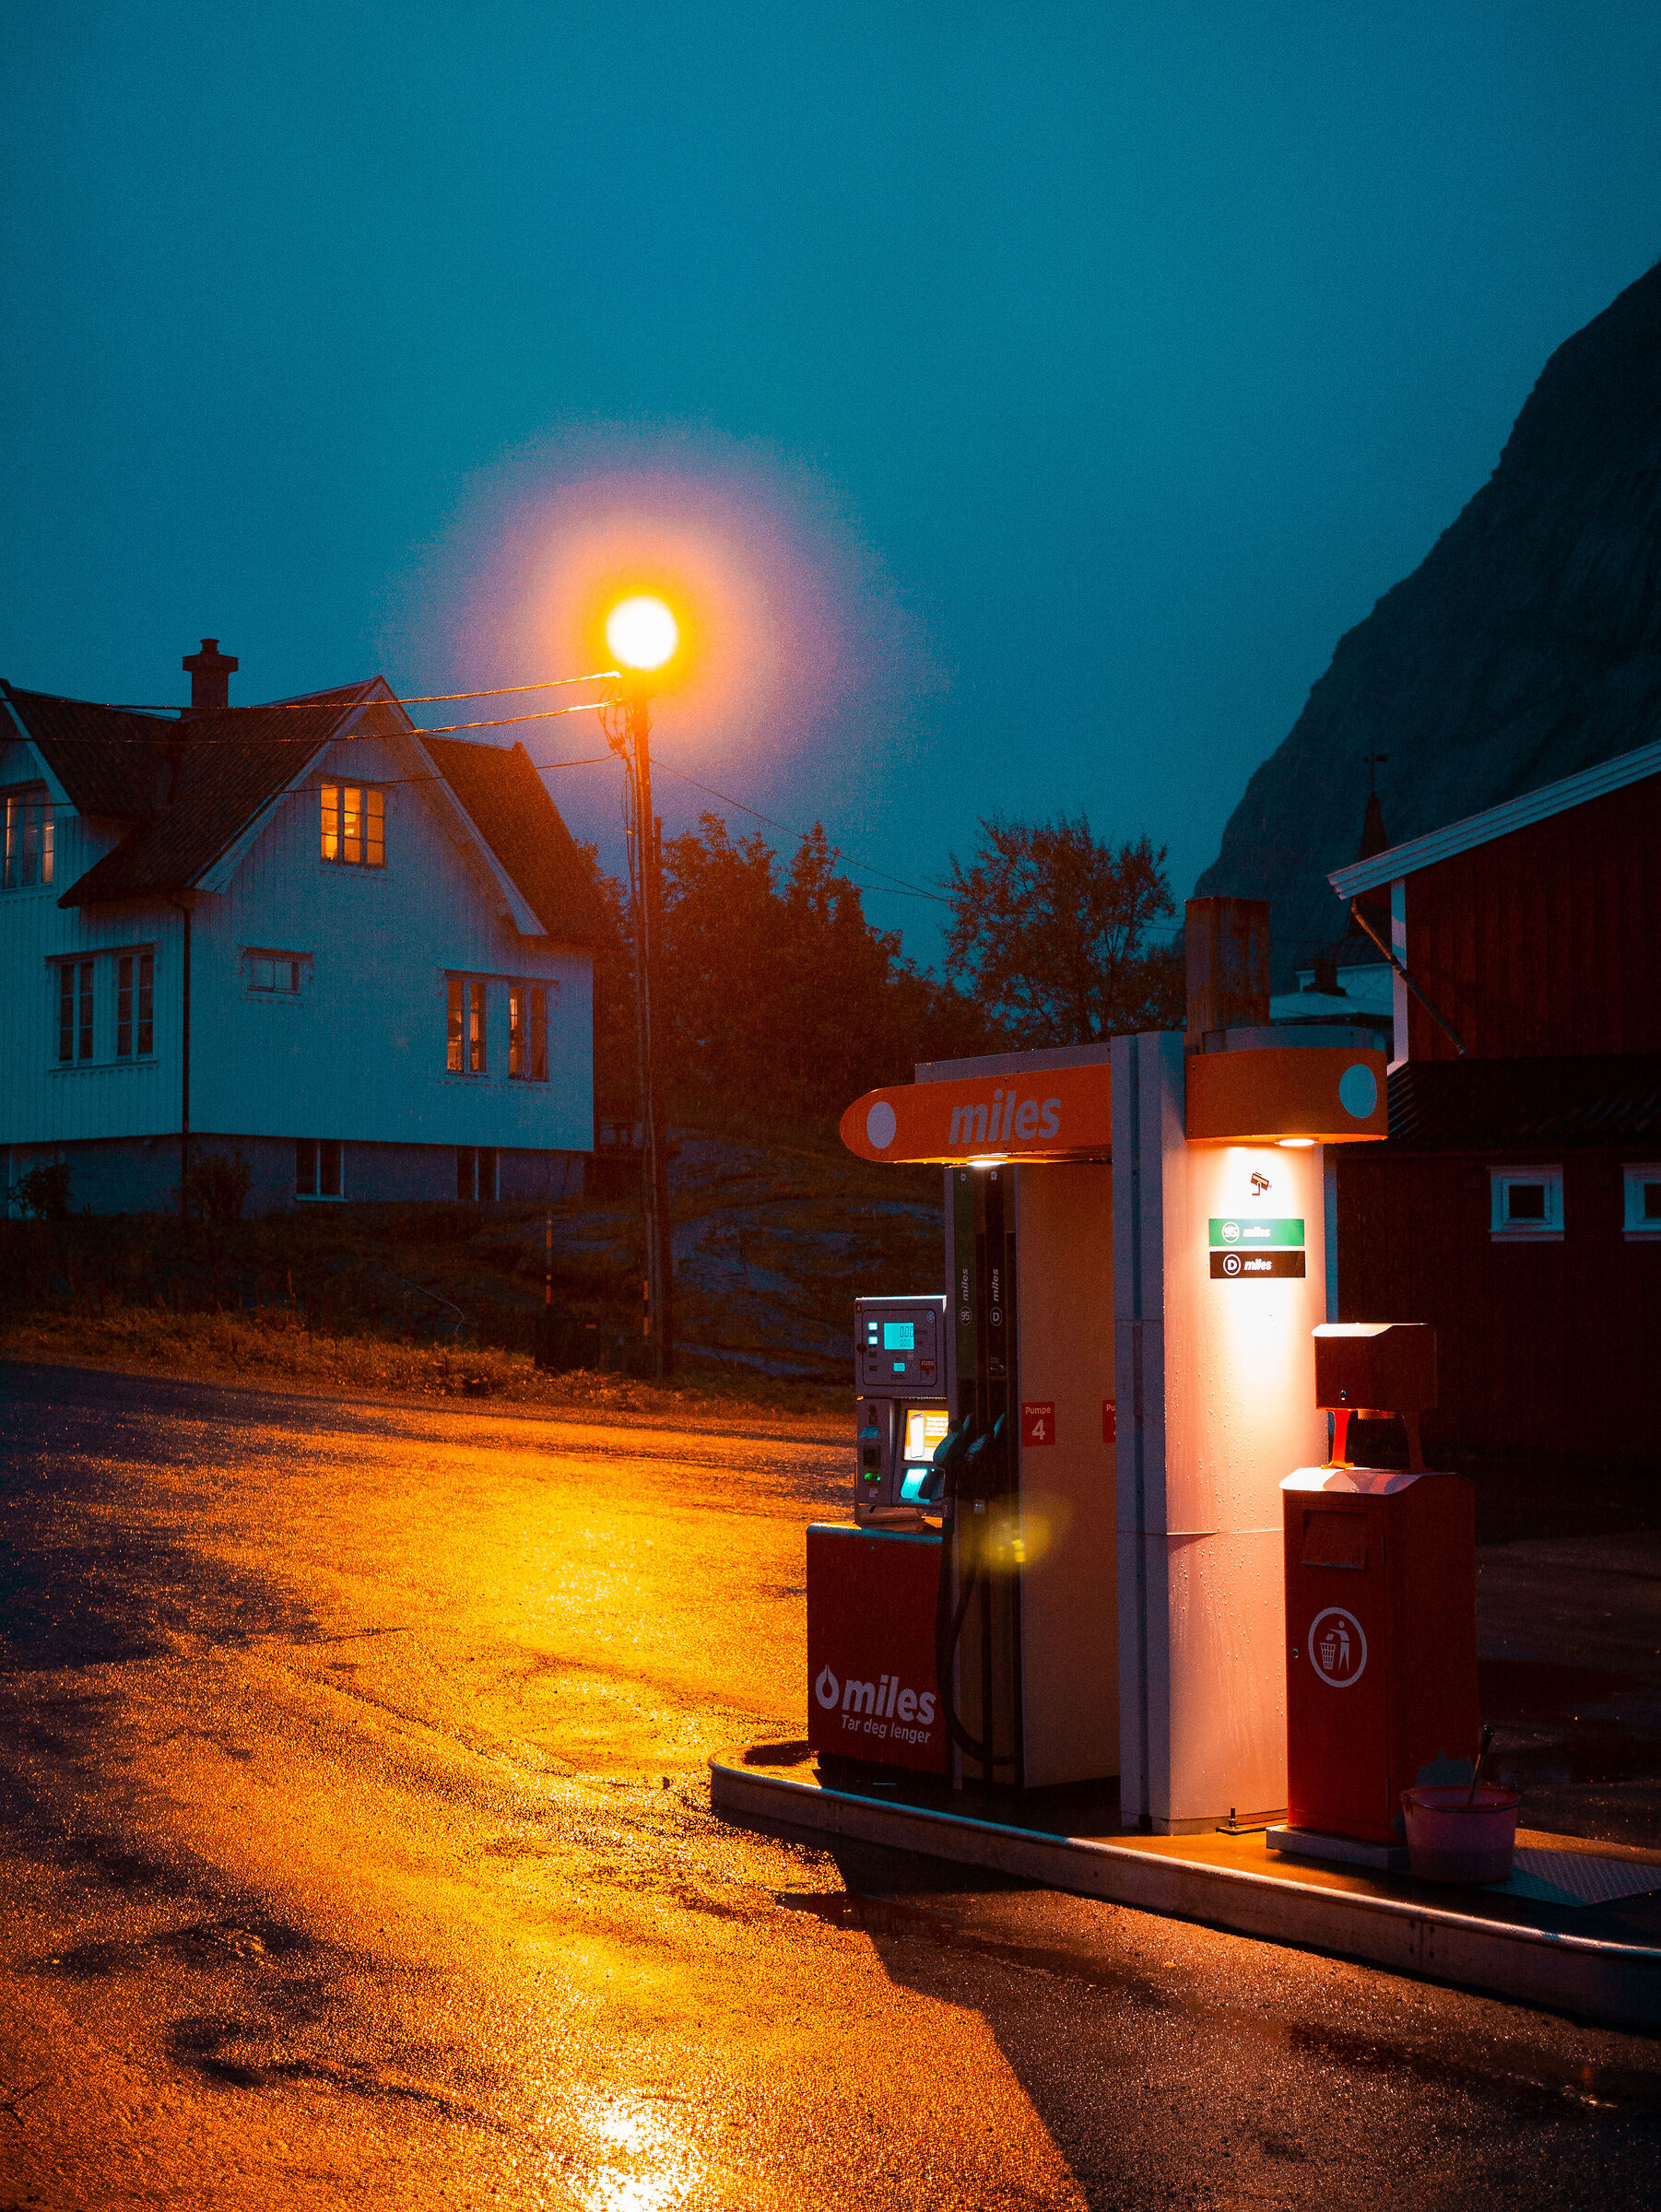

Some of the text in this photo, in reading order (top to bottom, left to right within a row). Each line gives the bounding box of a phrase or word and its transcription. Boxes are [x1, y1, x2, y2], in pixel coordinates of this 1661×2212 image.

[948, 1088, 1061, 1144] miles
[1227, 1258, 1272, 1271] D miles
[991, 1268, 1000, 1322] D miles
[960, 1311, 971, 1321] 95
[1025, 1406, 1052, 1417] Pumpe
[1031, 1419, 1046, 1441] 4
[842, 1674, 937, 1725] miles
[842, 1713, 931, 1745] Tar deg lenger
